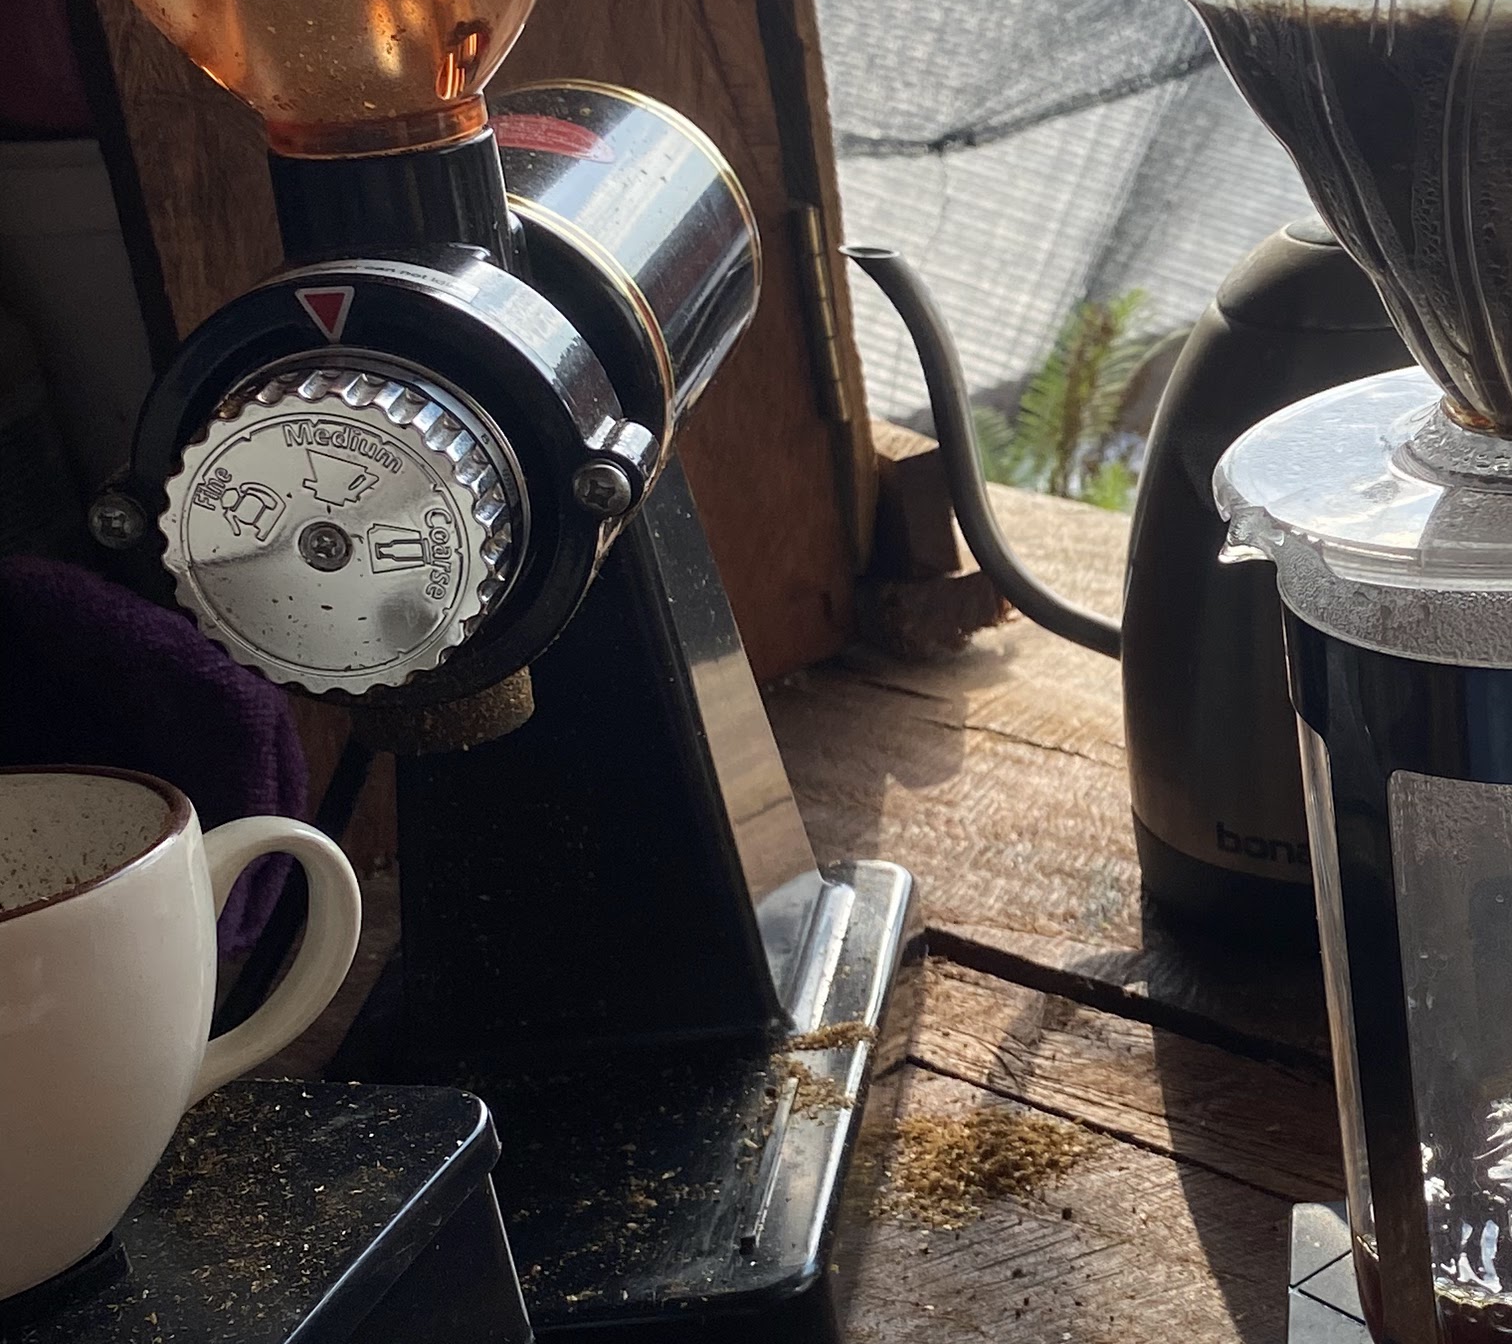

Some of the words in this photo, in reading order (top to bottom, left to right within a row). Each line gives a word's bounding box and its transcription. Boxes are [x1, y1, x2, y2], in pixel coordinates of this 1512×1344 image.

[282, 421, 404, 474] Medium
[193, 467, 232, 511] Fine
[424, 508, 452, 600] Coarse
